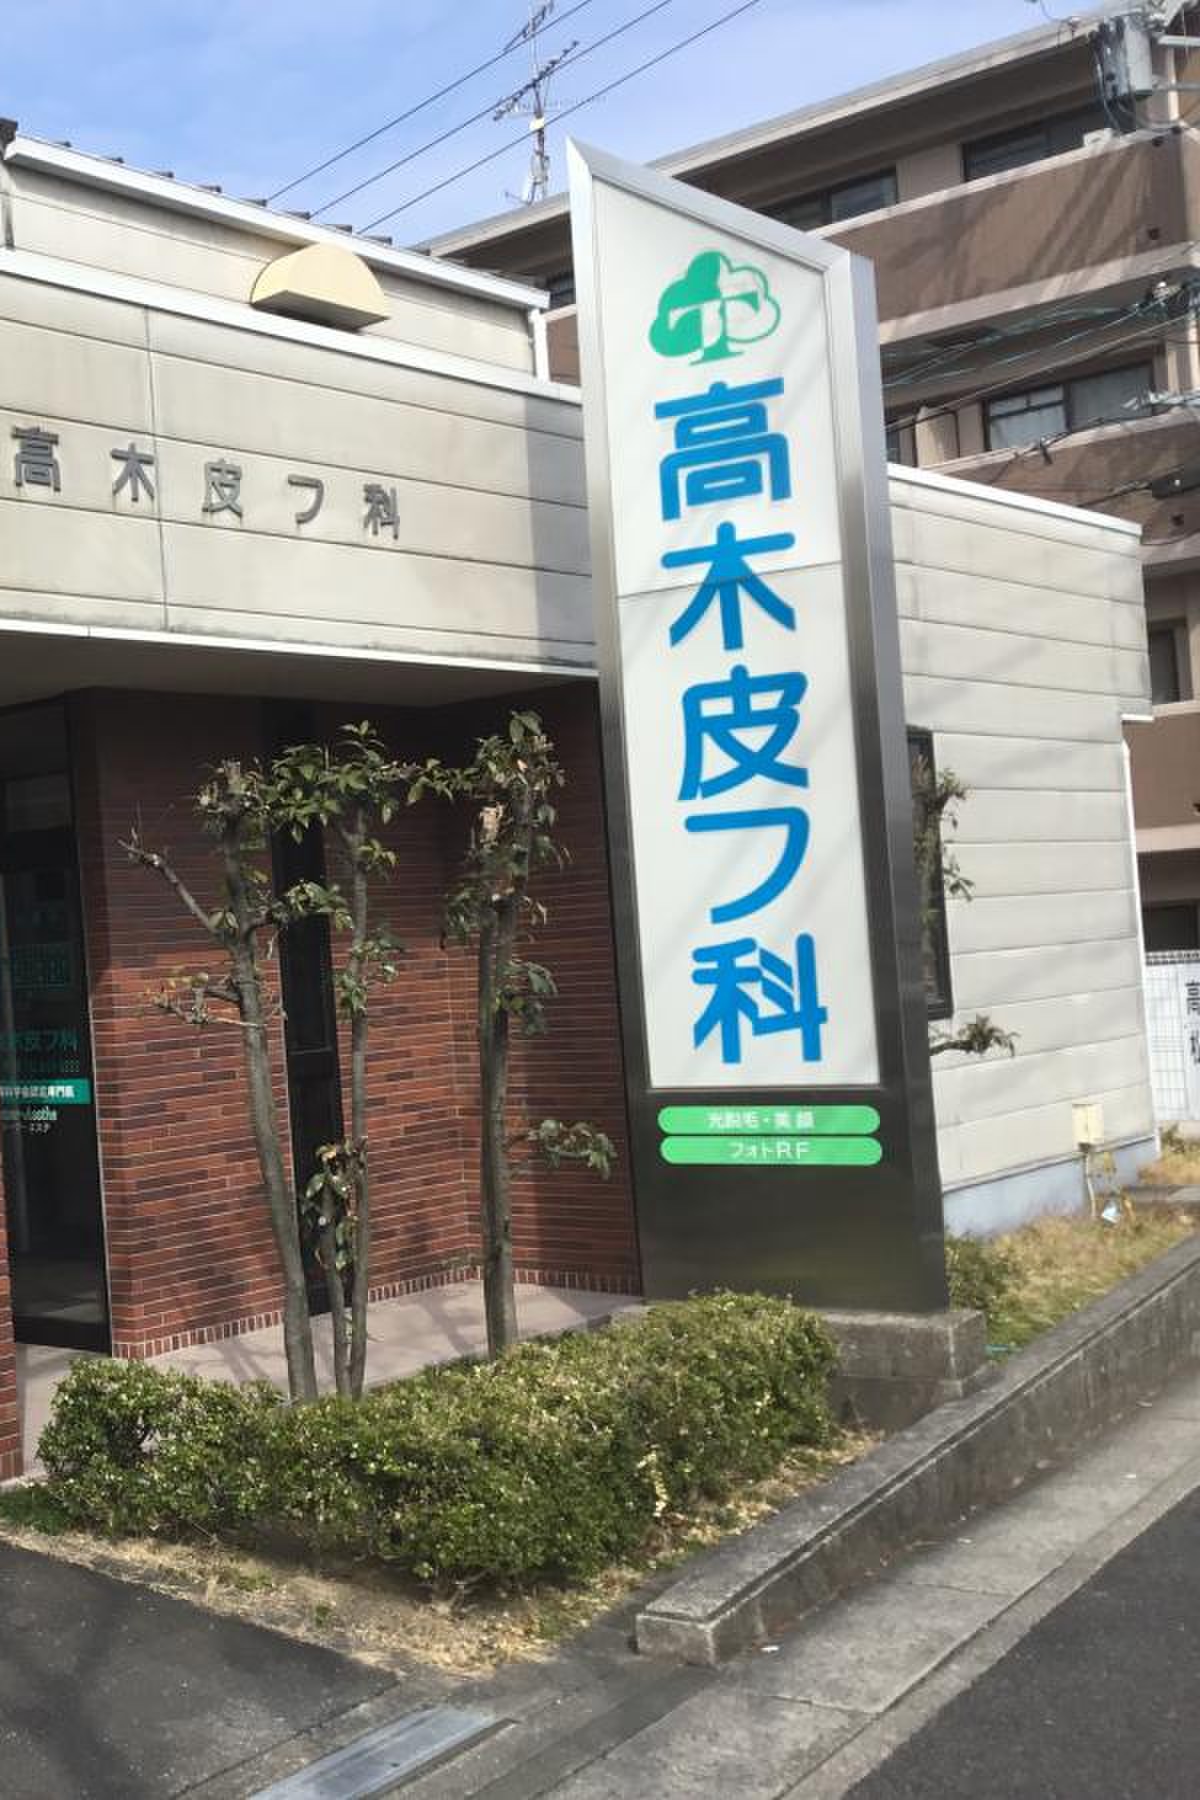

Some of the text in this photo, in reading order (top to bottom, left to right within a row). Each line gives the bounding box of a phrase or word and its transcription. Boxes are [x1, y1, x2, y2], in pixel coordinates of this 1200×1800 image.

[11, 425, 400, 540] 高木皮フ科
[653, 376, 828, 1064] 高木皮フ科
